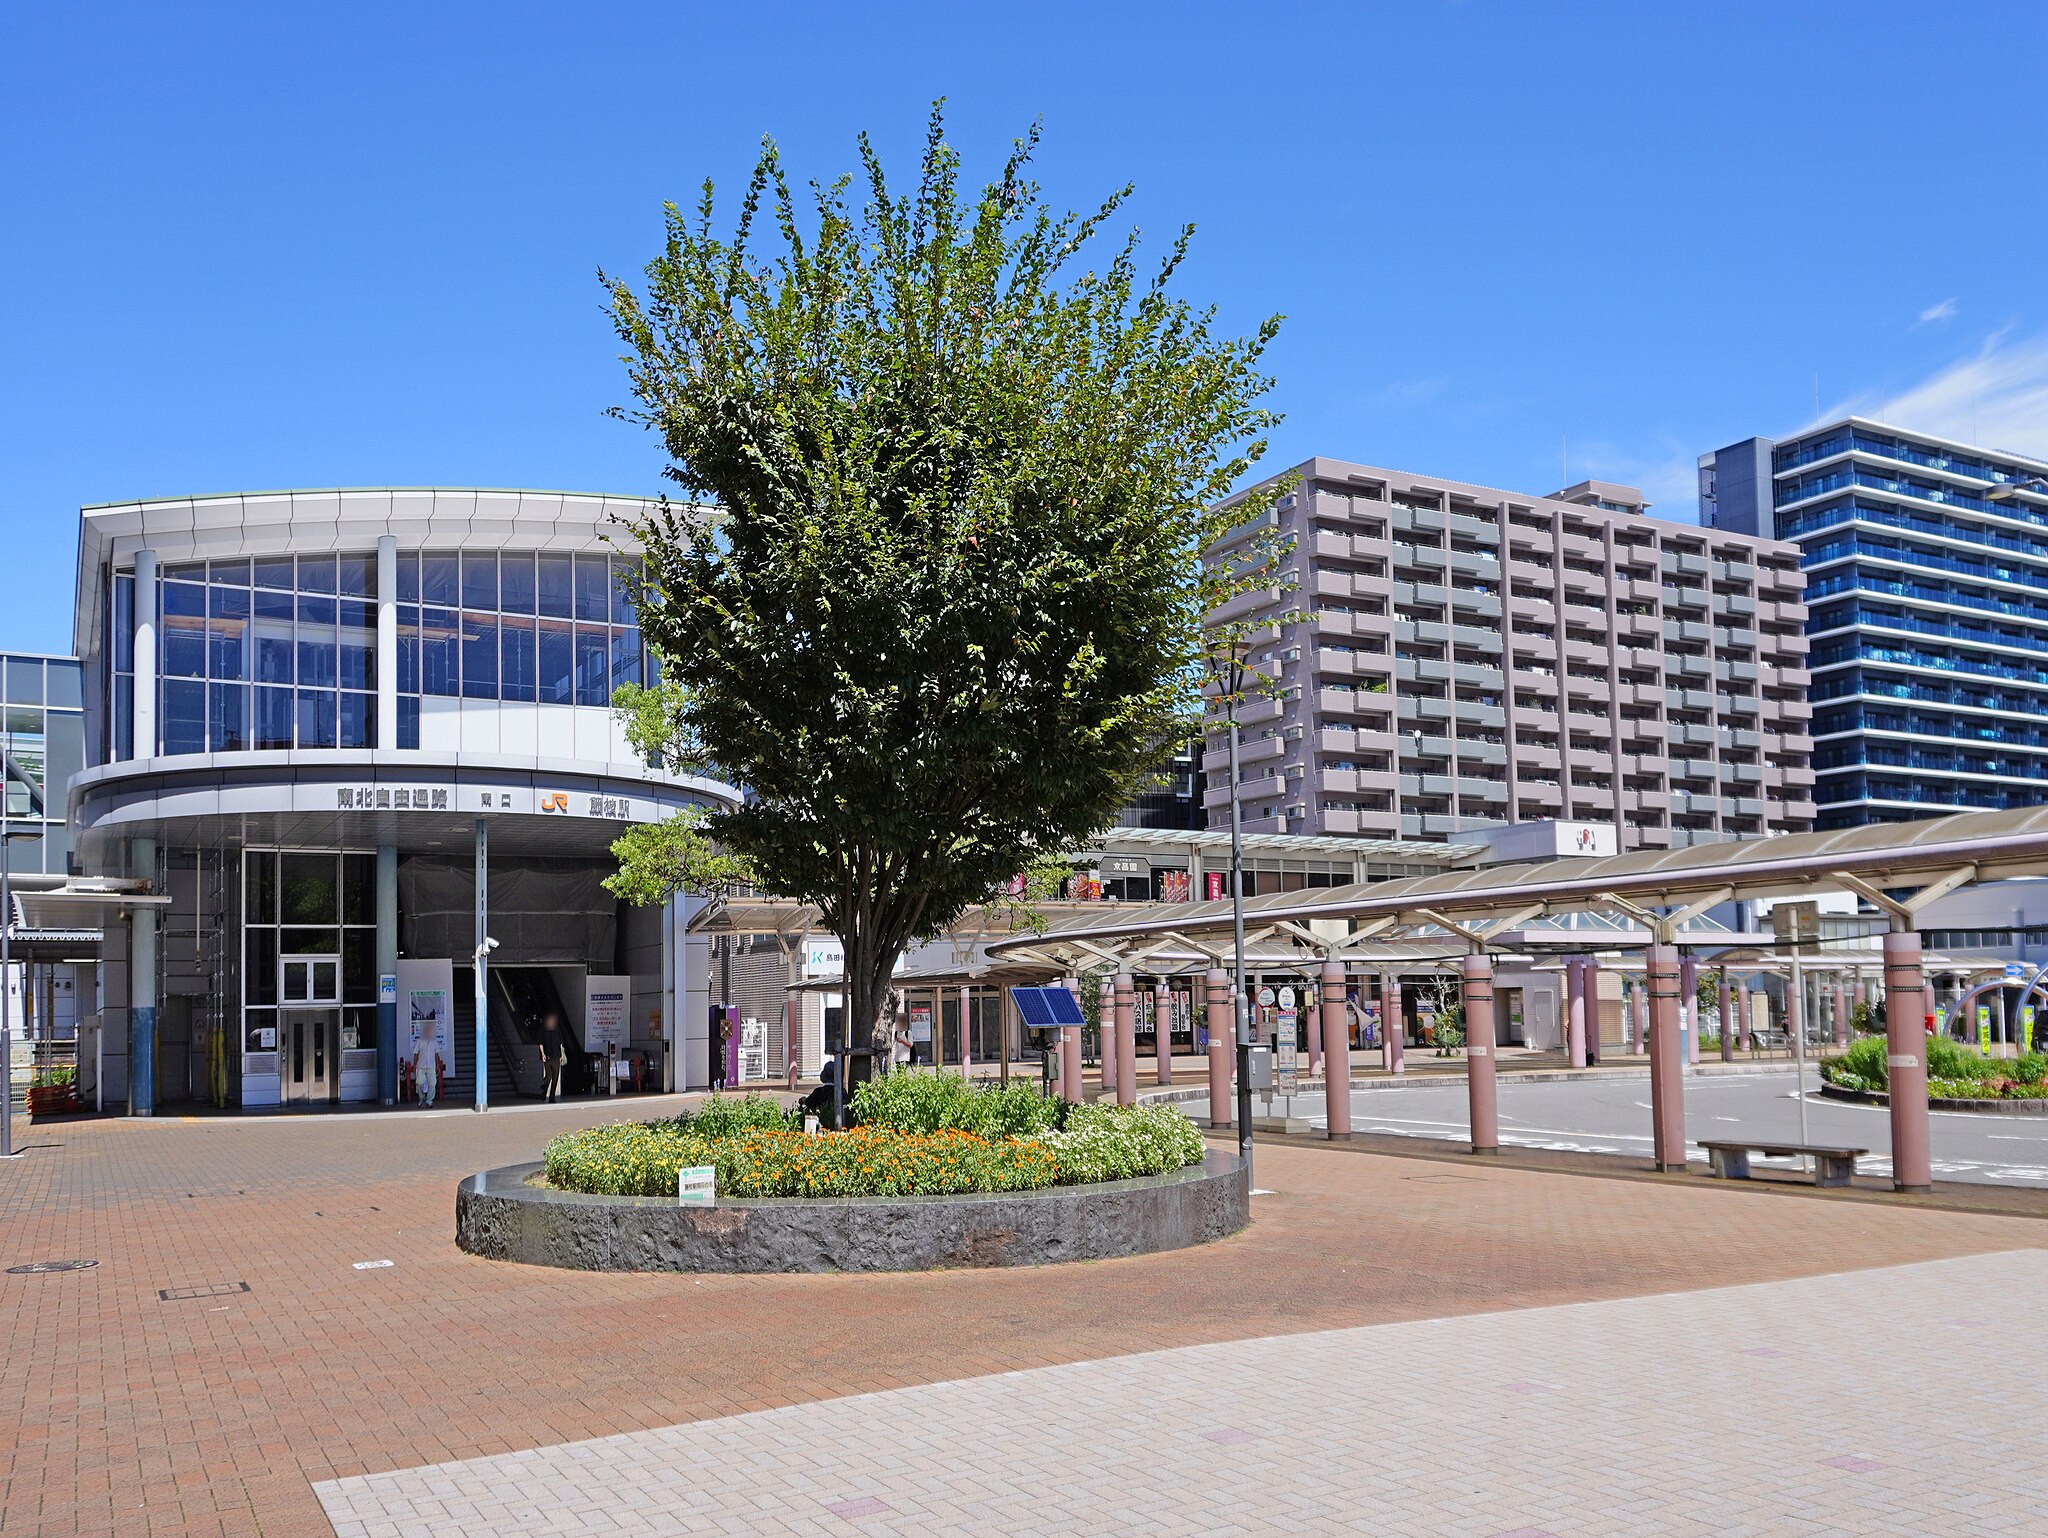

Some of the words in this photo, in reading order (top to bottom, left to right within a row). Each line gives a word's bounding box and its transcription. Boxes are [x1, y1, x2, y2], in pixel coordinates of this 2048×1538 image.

[337, 788, 448, 809] 南北自由通路
[480, 792, 511, 808] 南口
[541, 793, 568, 814] JR
